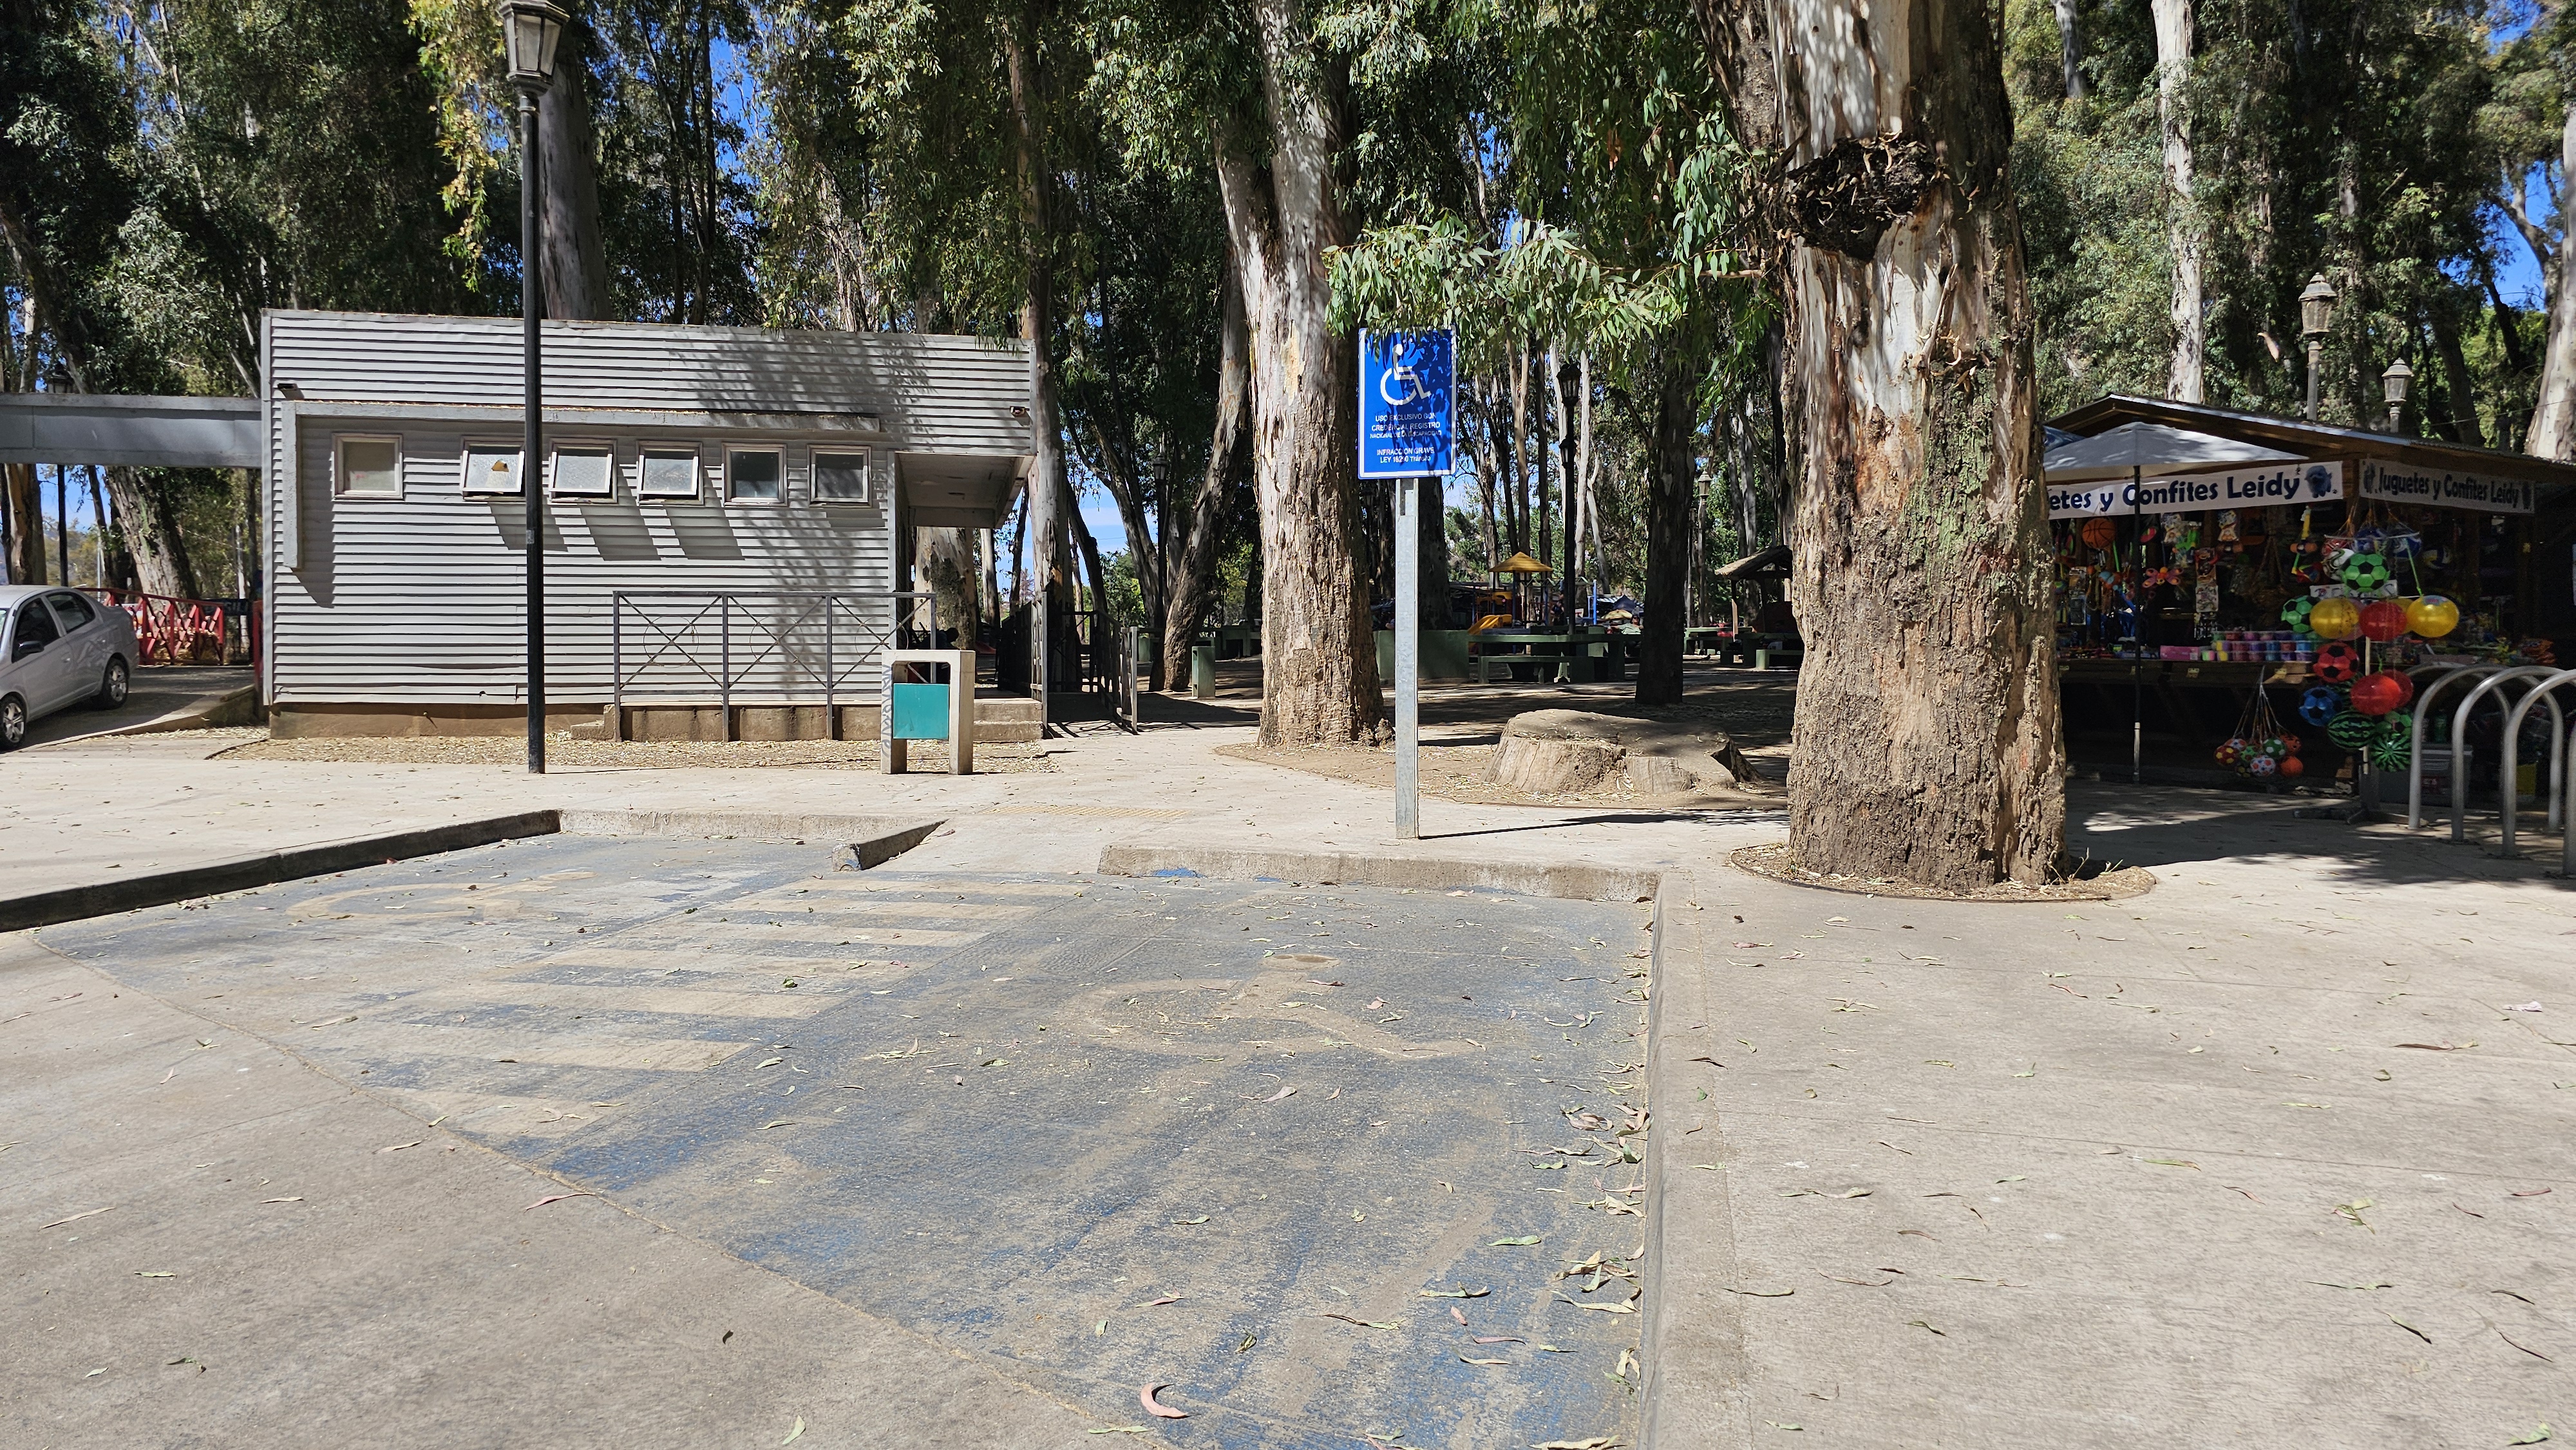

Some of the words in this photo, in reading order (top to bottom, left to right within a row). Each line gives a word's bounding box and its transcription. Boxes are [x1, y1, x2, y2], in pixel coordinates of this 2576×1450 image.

[1410, 421, 1441, 429] REGISTRO
[2049, 490, 2092, 511] etes
[2100, 492, 2114, 512] y
[2123, 480, 2218, 506] Confites
[2227, 471, 2300, 500] Leidy
[2378, 467, 2430, 496] Juguetes
[2432, 479, 2441, 500] y
[2443, 474, 2488, 501] Confites
[2490, 481, 2519, 509] Leidy
